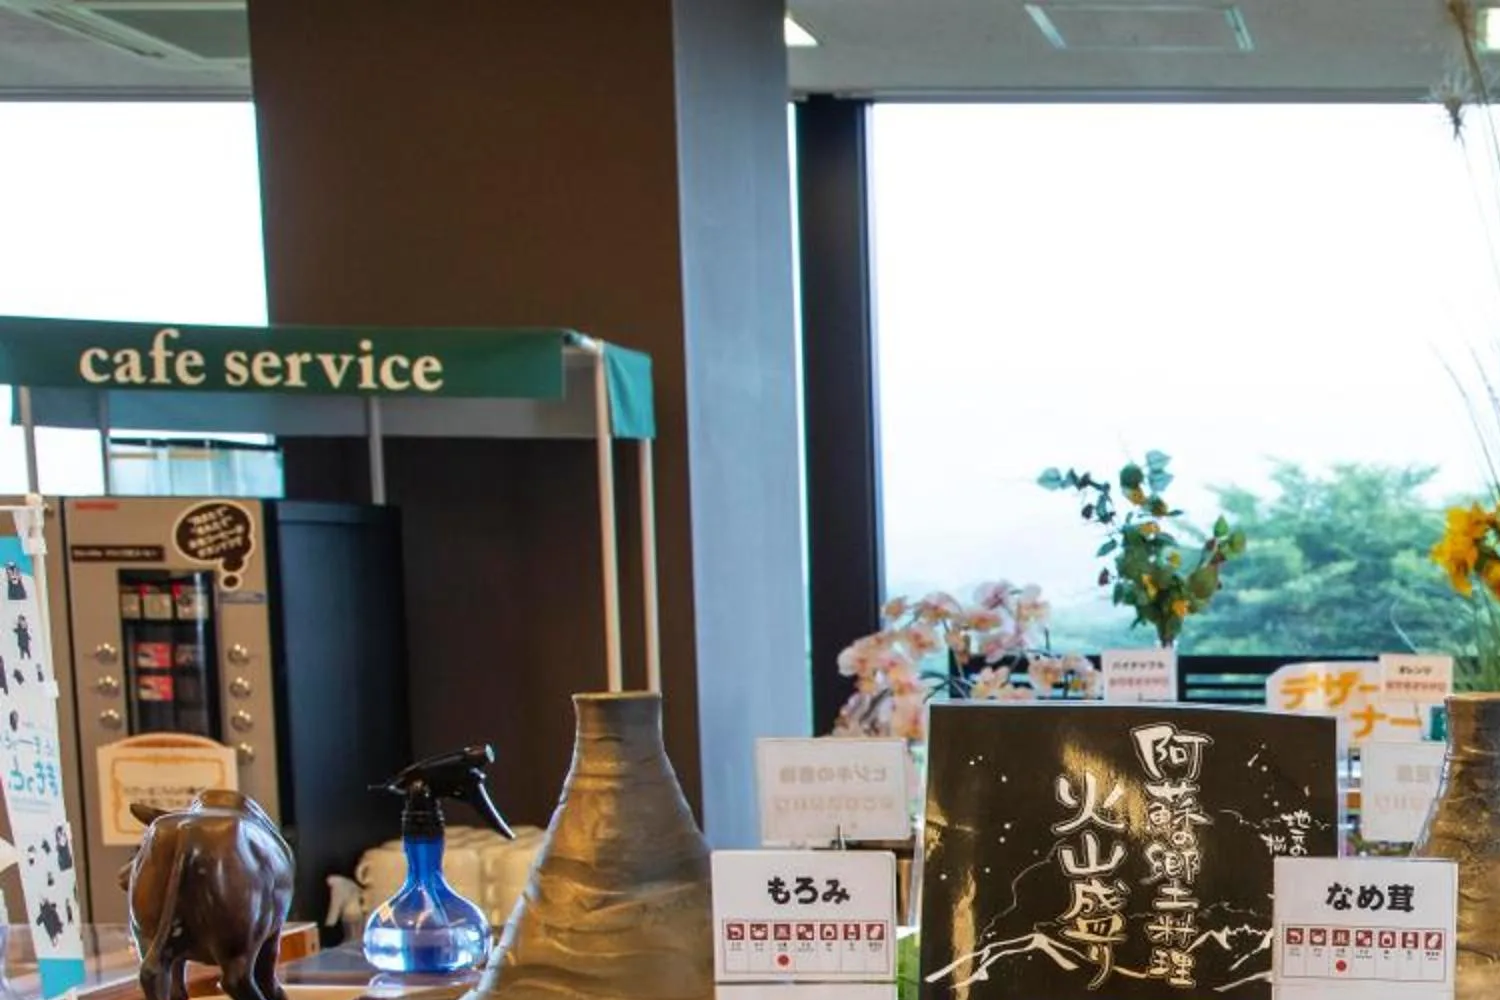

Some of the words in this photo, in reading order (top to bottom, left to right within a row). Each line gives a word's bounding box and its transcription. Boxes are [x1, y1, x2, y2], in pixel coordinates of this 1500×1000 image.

[79, 328, 206, 385] cafe
[225, 340, 444, 391] service
[1053, 769, 1128, 990] 火山盛り
[1132, 723, 1212, 988] 阿蘇の郷土料理
[767, 876, 850, 905] もろみ
[1325, 883, 1415, 913] なめ茸
